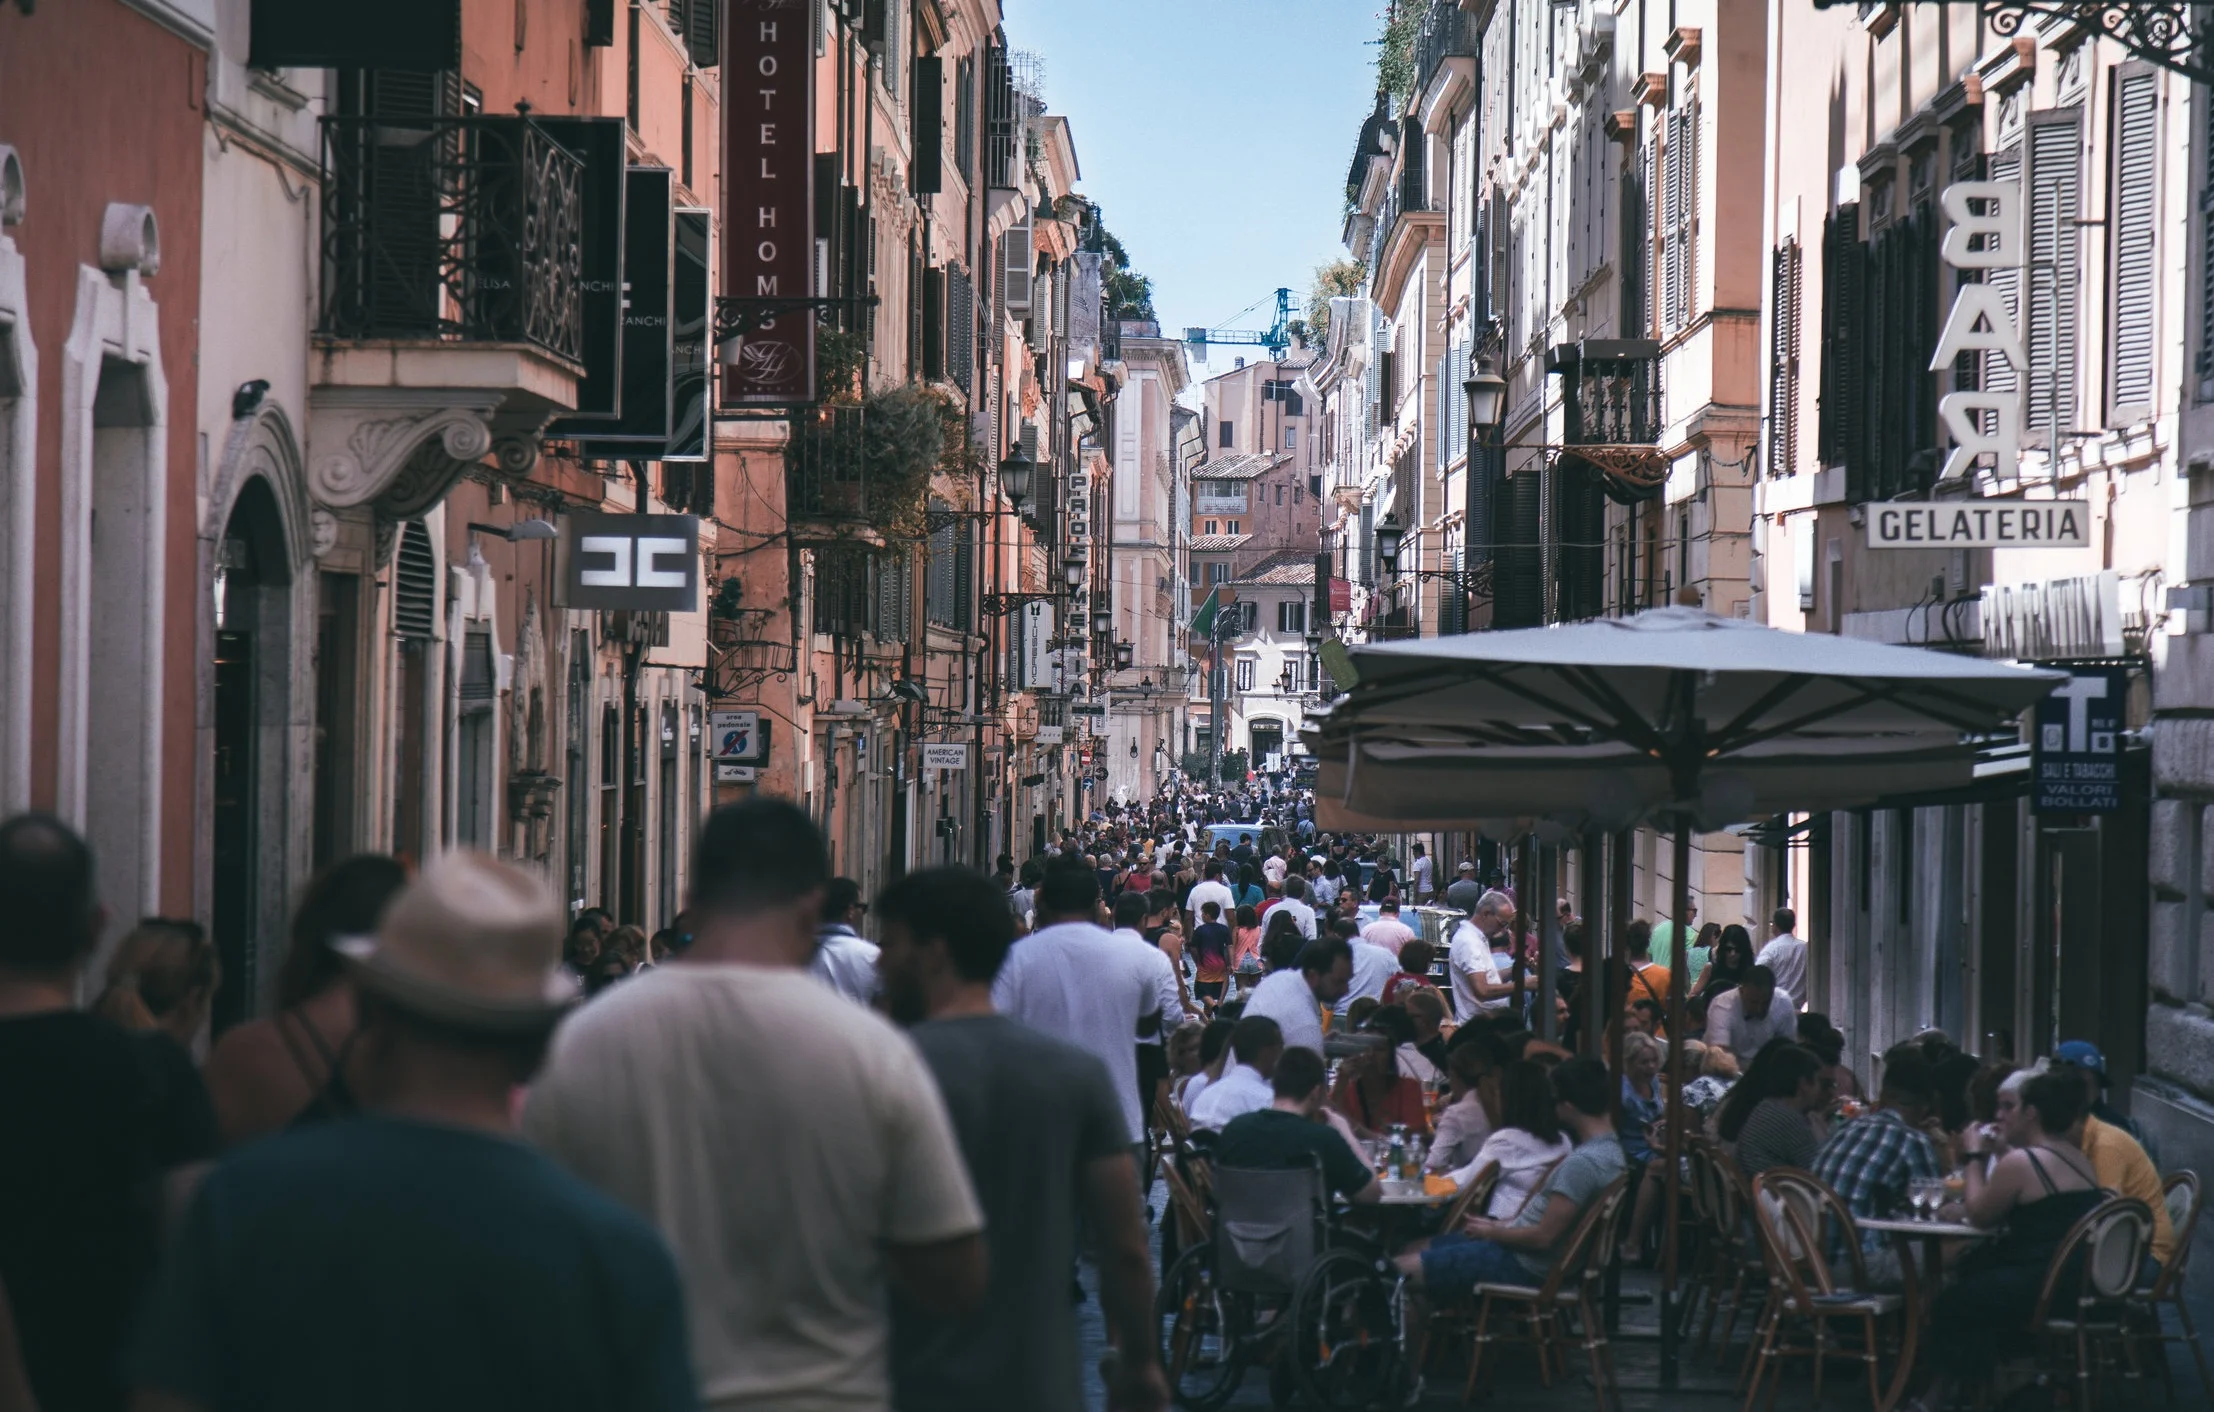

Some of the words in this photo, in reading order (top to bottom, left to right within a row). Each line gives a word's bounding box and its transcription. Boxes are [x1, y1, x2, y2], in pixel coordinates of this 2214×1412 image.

[759, 21, 778, 179] HOTEL
[579, 280, 615, 292] NCHI
[1879, 508, 2080, 542] GELATERIA
[1069, 475, 1088, 694] PROFMERIA
[1031, 616, 1039, 686] MORESCHI
[2050, 676, 2108, 753] T
[717, 721, 751, 729] pedonale
[927, 748, 964, 757] AMERICAN
[930, 757, 960, 765] VINTAGE
[2041, 762, 2061, 778] SALI
[2063, 762, 2070, 778] E
[2072, 762, 2116, 779] TABACCHI
[2045, 784, 2113, 795] VALORI
[2041, 796, 2118, 808] BOLLATI
